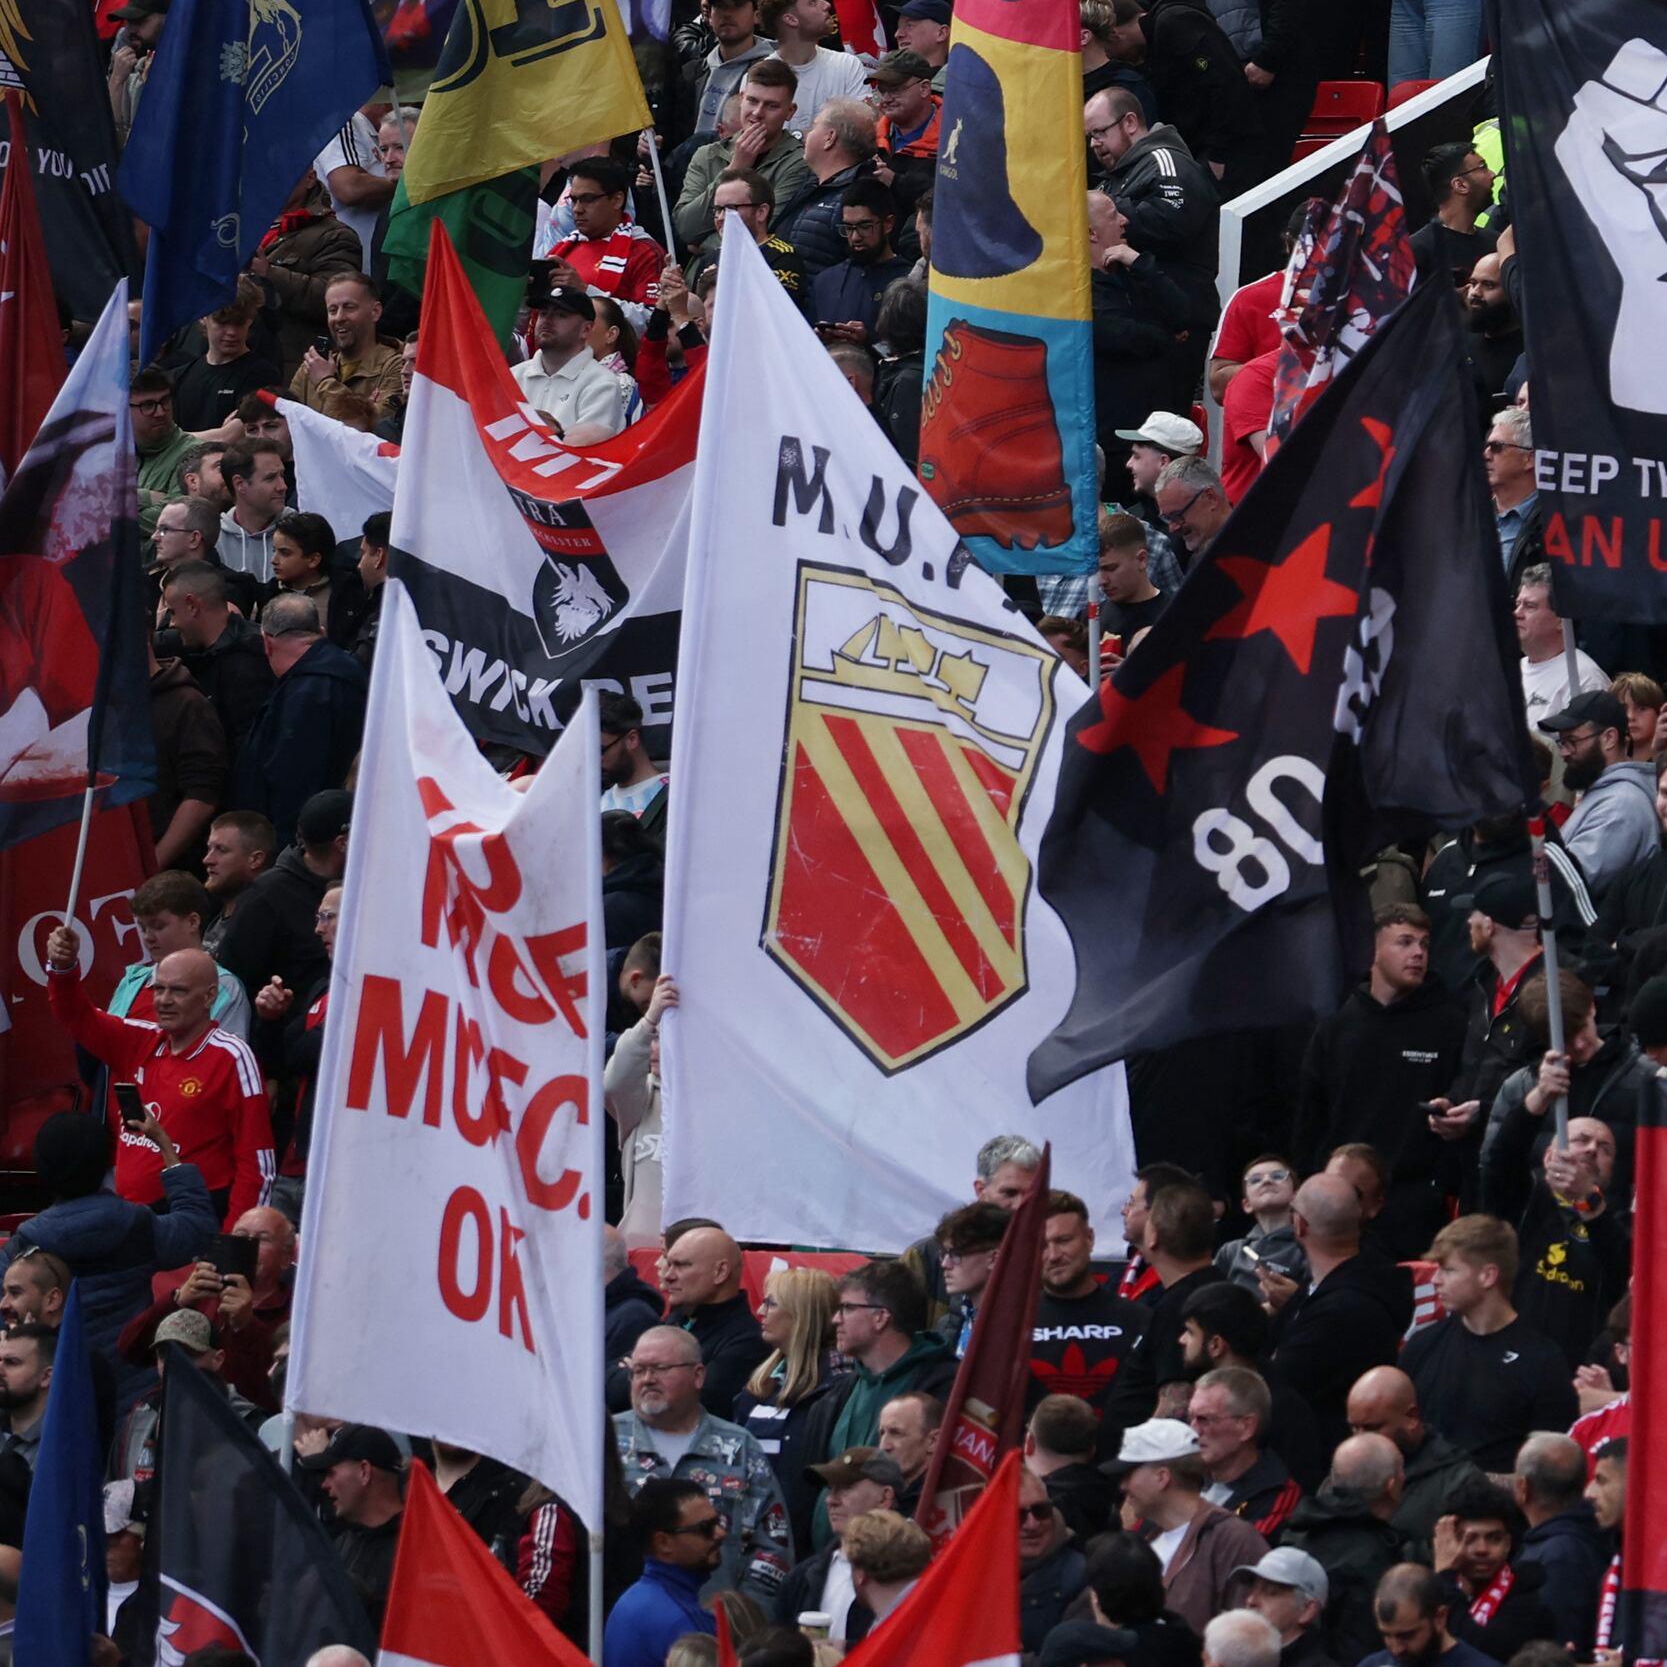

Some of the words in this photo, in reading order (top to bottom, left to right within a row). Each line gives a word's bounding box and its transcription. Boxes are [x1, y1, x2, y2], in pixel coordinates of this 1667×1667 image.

[1535, 448, 1620, 492] EEP
[1546, 520, 1624, 570] AN
[1032, 1323, 1123, 1342] SHARP
